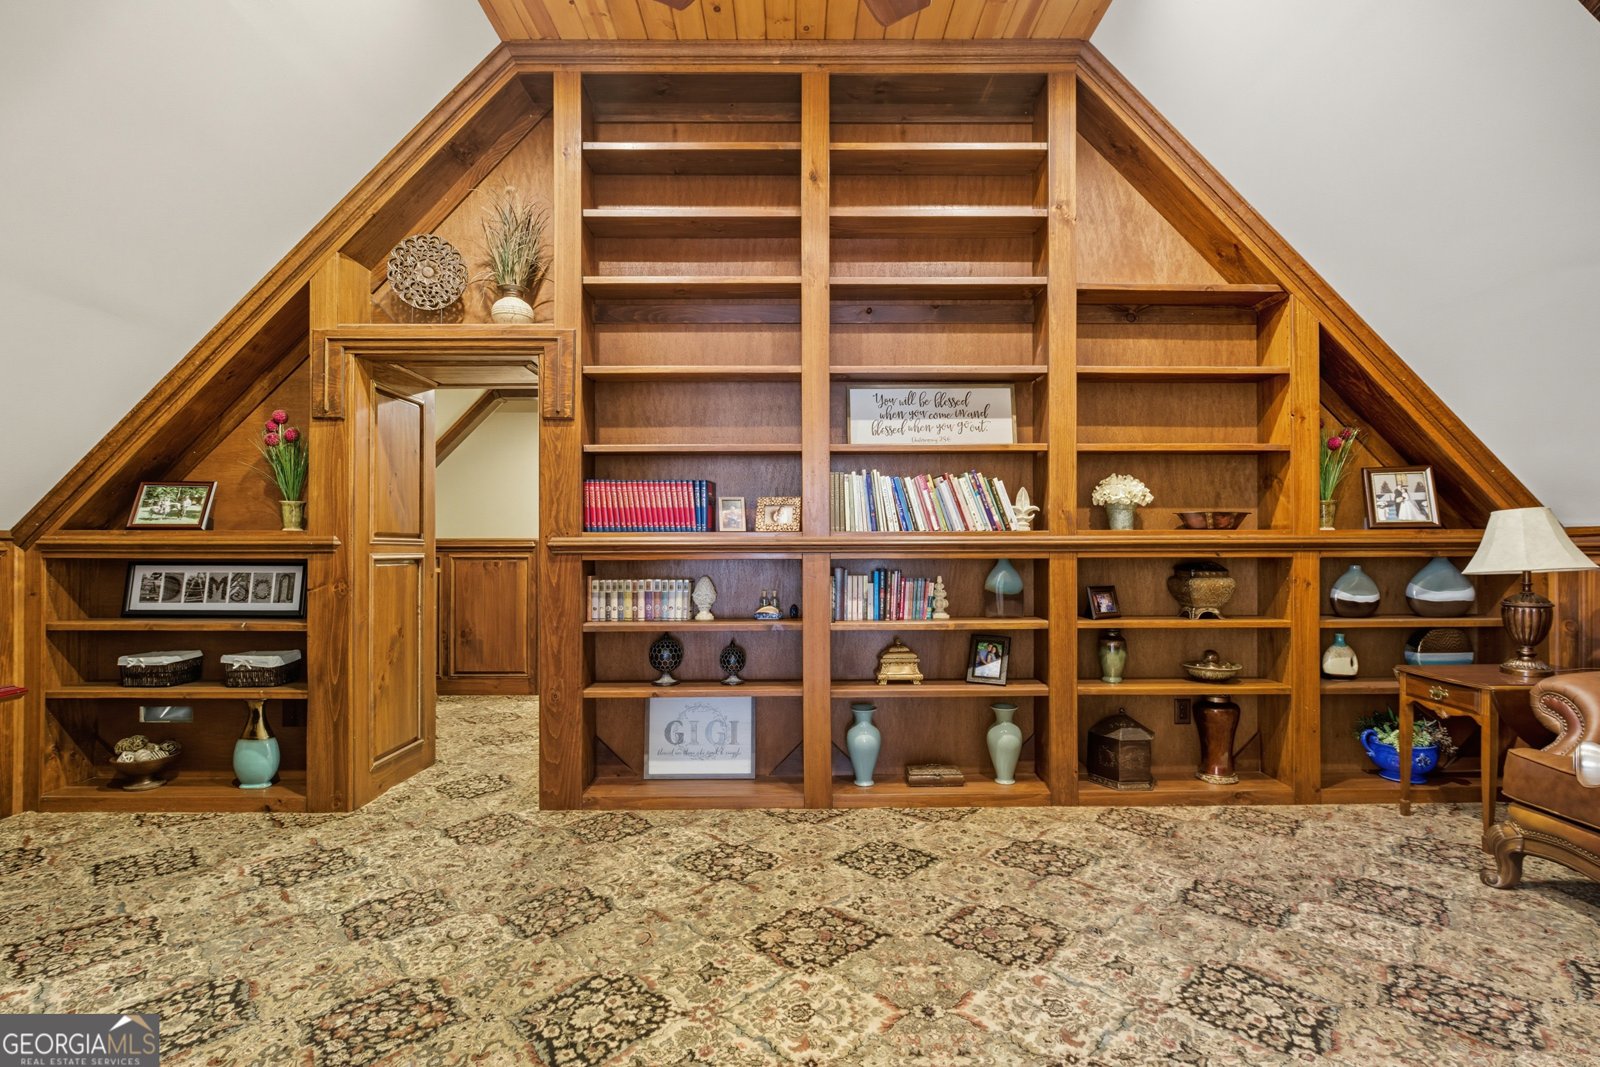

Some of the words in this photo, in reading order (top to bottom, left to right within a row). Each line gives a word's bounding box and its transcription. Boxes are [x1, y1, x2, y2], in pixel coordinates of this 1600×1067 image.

[872, 392, 897, 408] You
[899, 391, 917, 406] will
[918, 391, 931, 408] be
[934, 391, 972, 408] blessed
[880, 405, 908, 421] when
[908, 409, 928, 420] you
[928, 410, 955, 419] come
[967, 404, 990, 419] and
[871, 418, 908, 436] blessed
[908, 418, 935, 432] when
[935, 421, 957, 435] you
[956, 420, 972, 434] go
[664, 720, 740, 746] GIGI
